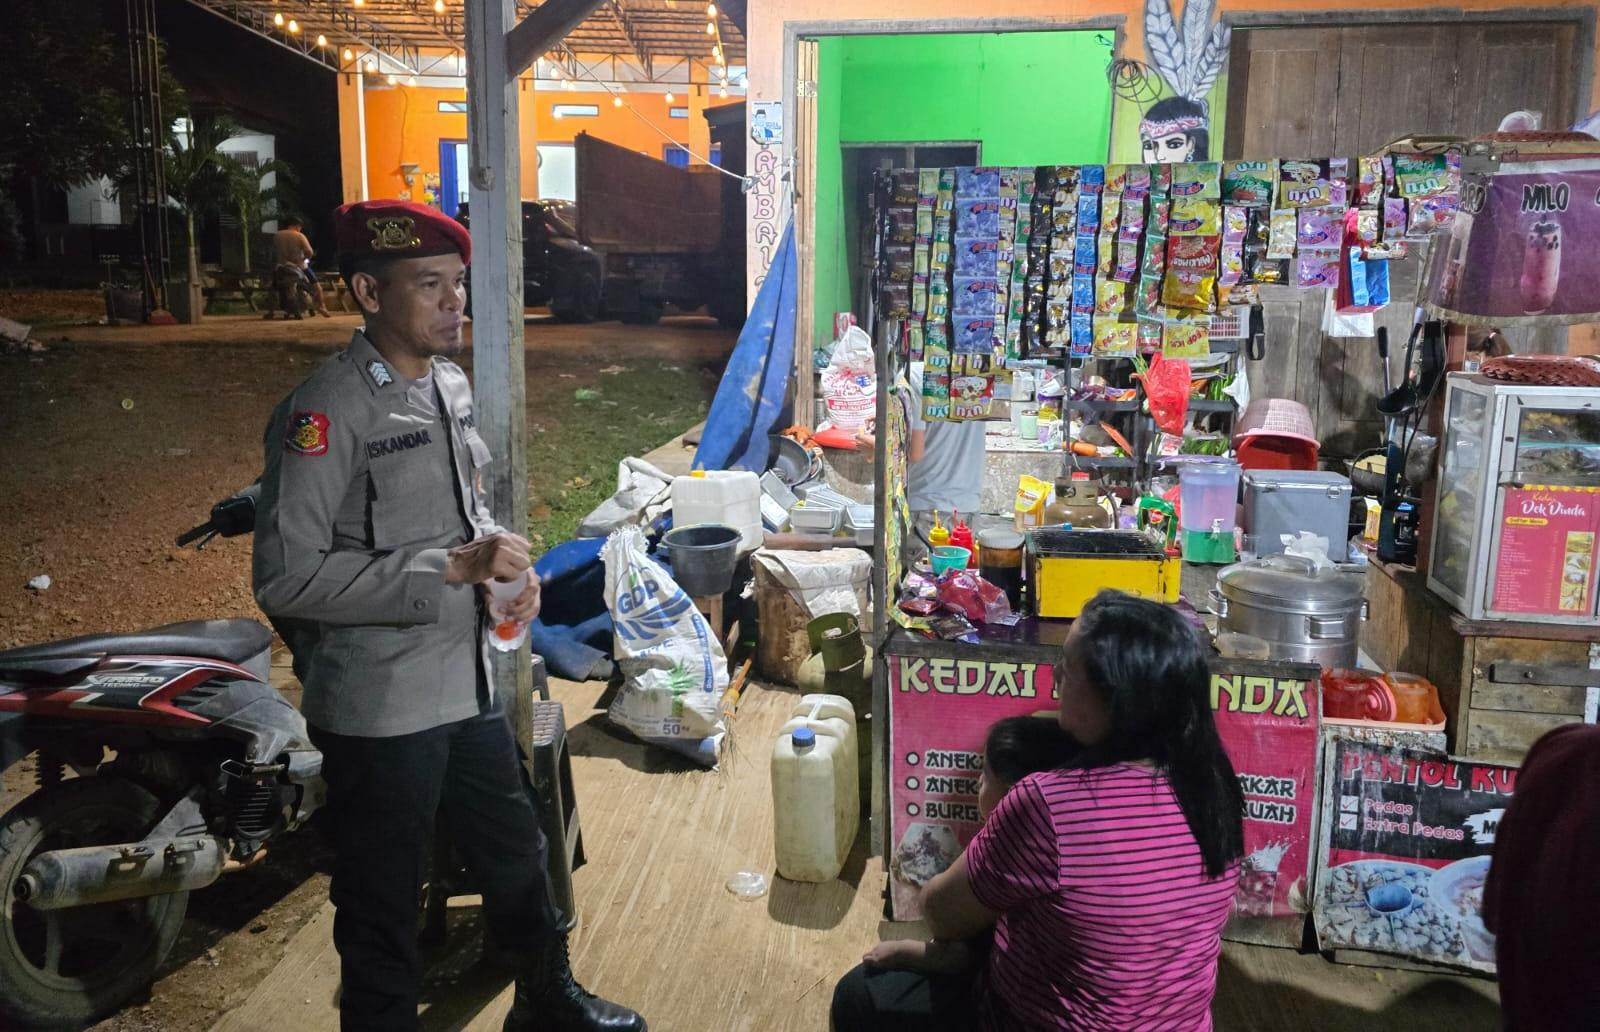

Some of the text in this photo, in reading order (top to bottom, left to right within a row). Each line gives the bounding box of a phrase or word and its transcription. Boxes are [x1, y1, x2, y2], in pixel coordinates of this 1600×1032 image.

[1521, 182, 1571, 214] MILO
[367, 430, 433, 459] ISKANDAR
[1521, 500, 1585, 516] Dek Dinda
[618, 580, 659, 614] GDP
[900, 657, 1036, 698] KEDAI
[1210, 674, 1309, 718] NDA
[663, 724, 681, 735] 50
[925, 750, 984, 769] ANEK
[925, 776, 979, 795] ANEK
[1342, 751, 1516, 796] PENTOL KU
[1238, 774, 1296, 798] AKAR
[925, 803, 979, 823] BURG
[1363, 798, 1414, 815] Pedas
[1362, 817, 1410, 836] Extra
[1411, 821, 1465, 841] Pedas
